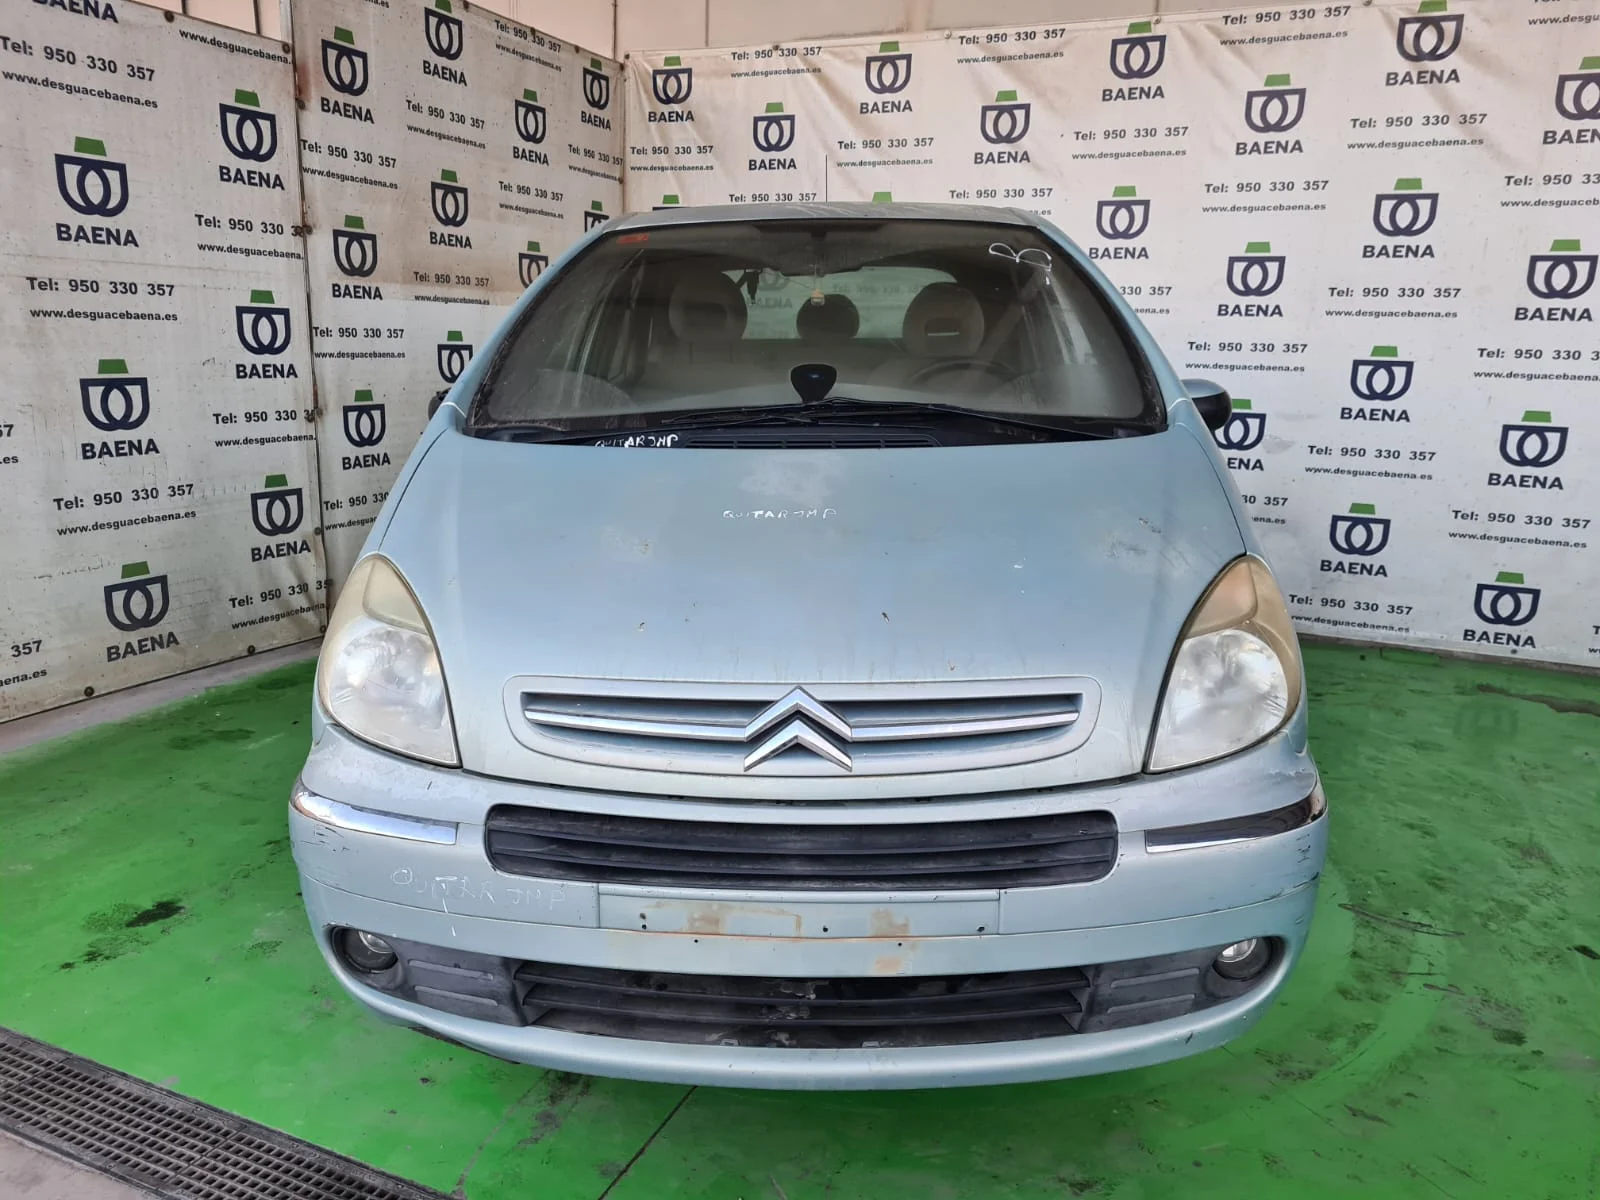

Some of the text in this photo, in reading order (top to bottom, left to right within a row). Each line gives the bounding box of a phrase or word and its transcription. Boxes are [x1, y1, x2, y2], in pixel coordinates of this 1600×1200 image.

[32, 0, 119, 24] AENA
[1221, 5, 1351, 26] Tel: 950 330 357
[958, 28, 1066, 45] Tel: 950 330 357
[1219, 28, 1349, 46] www.desguacebaena.es
[178, 28, 294, 66] www.desguacebaena.
[731, 46, 822, 61] Tel: 950 330 357
[0, 35, 155, 82] Tel: 950 330 357
[957, 51, 1064, 64] www.desguacebaena.es
[422, 59, 468, 87] BAENA
[1385, 68, 1460, 86] BAENA
[1, 71, 158, 109] www.desguacebaena.es
[1102, 85, 1165, 102] BAENA
[320, 96, 375, 125] BAENA
[859, 99, 913, 115] BAENA
[581, 110, 612, 132] BAENA
[648, 110, 695, 123] BAENA
[1350, 113, 1488, 129] Tel: 950 330 357
[1074, 126, 1189, 141] Tel: 950 330 357
[630, 145, 714, 155] Tel: 950 330 357
[837, 137, 934, 150] Tel: 950 330 357
[1235, 139, 1303, 156] BAENA
[1347, 138, 1484, 150] www.desguacebaena.es
[300, 138, 397, 169] Tel: 950 330 357
[512, 146, 550, 166] BAENA
[974, 150, 1031, 165] BAENA
[1072, 149, 1187, 160] www.desguacebaena.es
[748, 158, 797, 171] BAENA
[837, 159, 934, 167] www.desguacebaena.es
[218, 164, 286, 191] BAENA
[1504, 174, 1572, 186] Tel: 950
[949, 188, 1053, 200] Tel: 950 330 357
[1204, 180, 1329, 193] Tel: 950 330 357
[1202, 204, 1327, 213] www.desguacebaena.es
[194, 213, 221, 229] Tel:
[228, 218, 253, 232] 950
[260, 221, 284, 236] 330
[55, 222, 140, 248] BAENA
[429, 231, 473, 250] BAENA
[1089, 246, 1149, 260] BAENA
[1362, 244, 1435, 259] BAENA
[25, 276, 175, 297] Tel: 950 330 357
[331, 283, 383, 301] BAENA
[1149, 286, 1172, 296] 357
[1328, 287, 1461, 298] Tel: 950 330 357
[29, 308, 178, 322] www.desguacebaena.es
[1217, 304, 1283, 317] BAENA
[1325, 309, 1458, 319] www.desguacebaena.es
[1514, 307, 1593, 322] BAENA
[312, 326, 404, 339] Tel: 950 330 357
[1187, 341, 1308, 353] Tel: 950 330 357
[1477, 348, 1505, 359] Tel:
[1514, 348, 1543, 360] 950
[1552, 349, 1582, 361] 330
[235, 363, 299, 380] BAENA
[1185, 362, 1305, 372] www.desguacebaena.es
[212, 412, 238, 425] Tel:
[244, 411, 268, 423] 950
[274, 409, 297, 422] 330
[1340, 407, 1410, 423] BAENA
[80, 438, 161, 460] BAENA
[1307, 445, 1437, 461] Tel: 950 330 357
[341, 452, 391, 471] BAENA
[1227, 457, 1265, 472] ENA
[1305, 467, 1433, 480] www.desguacebaena.es
[1487, 472, 1564, 490] BAENA
[52, 483, 194, 511] Tel: 950 330 357
[322, 495, 368, 511] Tel: 950
[1263, 496, 1289, 507] 357
[56, 510, 197, 536] www.desguacebaena.es
[1451, 509, 1591, 529] Tel: 950 330 357
[1448, 532, 1587, 548] www.desguacebaena.es
[250, 539, 312, 563] BAENA
[1319, 559, 1388, 578] BAENA
[228, 594, 254, 609] Tel:
[260, 588, 282, 602] 950
[287, 582, 309, 597] 330
[1288, 594, 1413, 615] Tel: 950 330 357
[1463, 629, 1536, 648] BAENA
[10, 639, 43, 658] 357
[106, 631, 180, 663] BAENA
